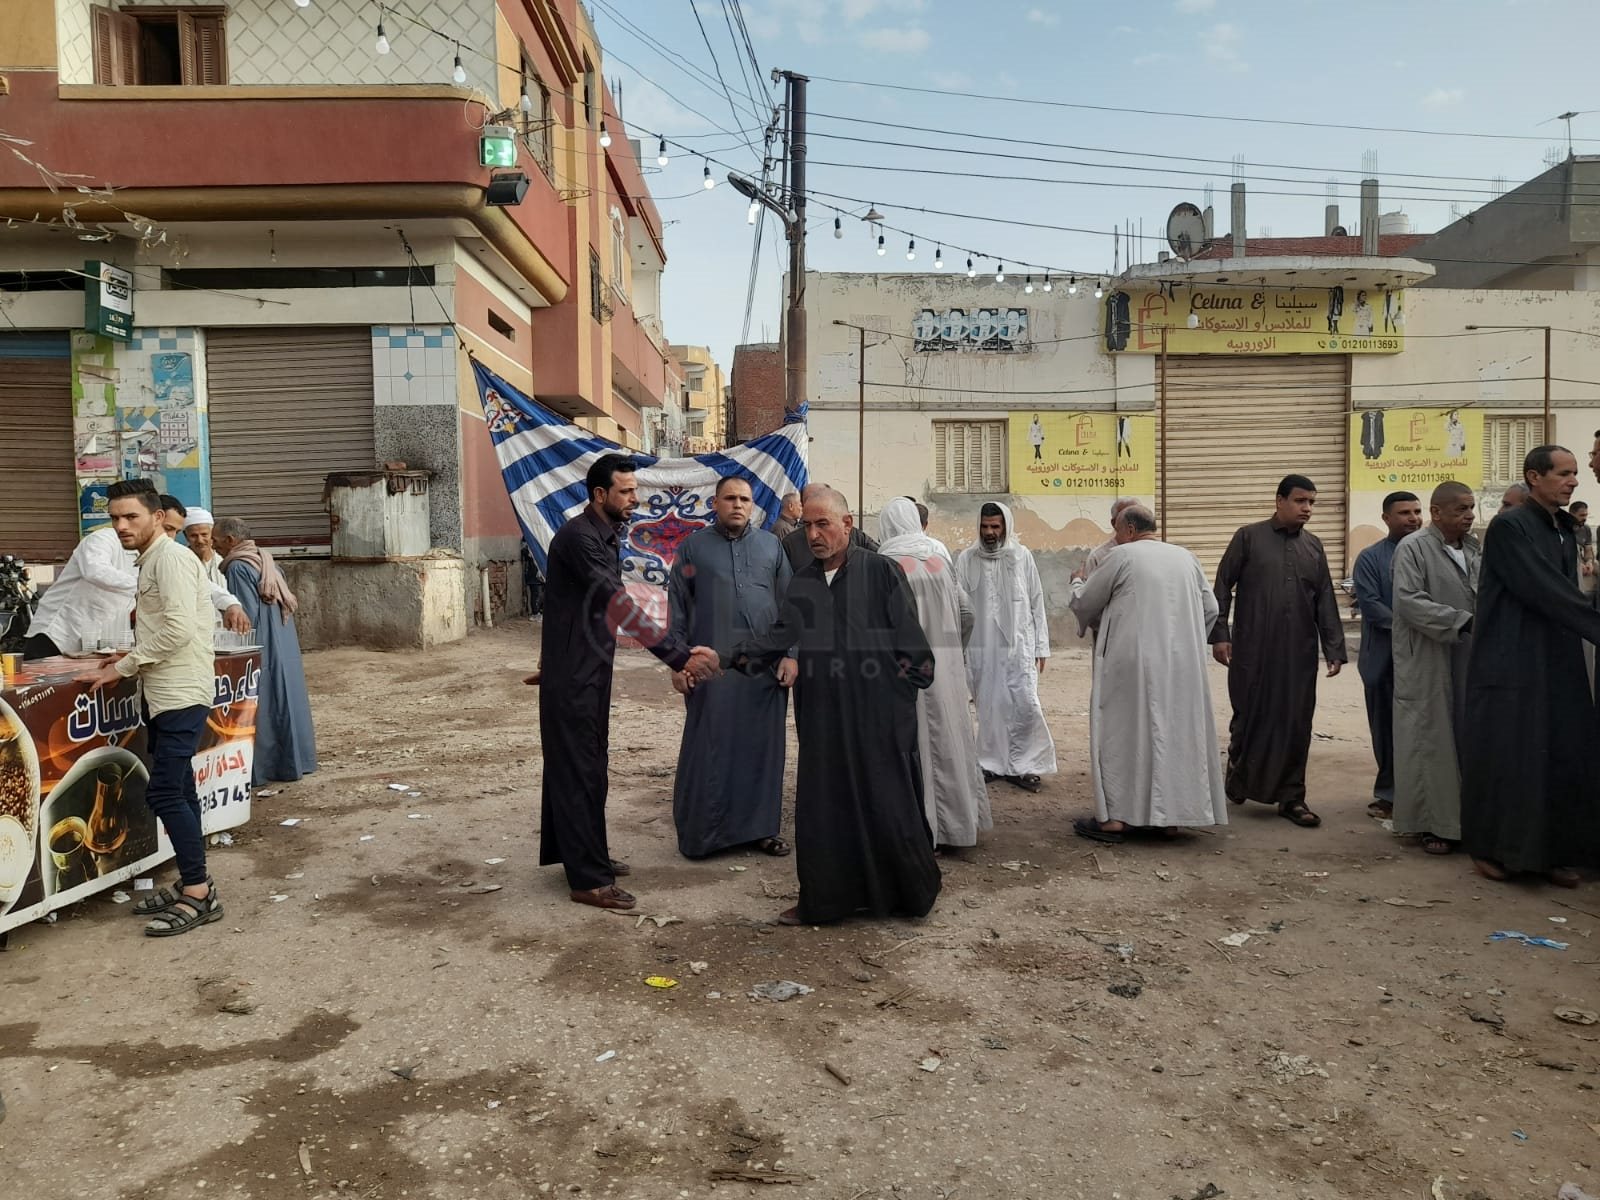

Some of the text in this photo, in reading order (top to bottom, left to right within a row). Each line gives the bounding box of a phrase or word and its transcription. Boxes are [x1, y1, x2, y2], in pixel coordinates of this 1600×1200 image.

[1251, 292, 1265, 310] &
[1275, 294, 1318, 313] سيلينا
[1254, 321, 1263, 332] و
[1265, 317, 1312, 333] للملابس
[1341, 339, 1398, 349] 01210113693
[1066, 478, 1125, 488] 01210113693
[1401, 473, 1455, 483] 01210113693
